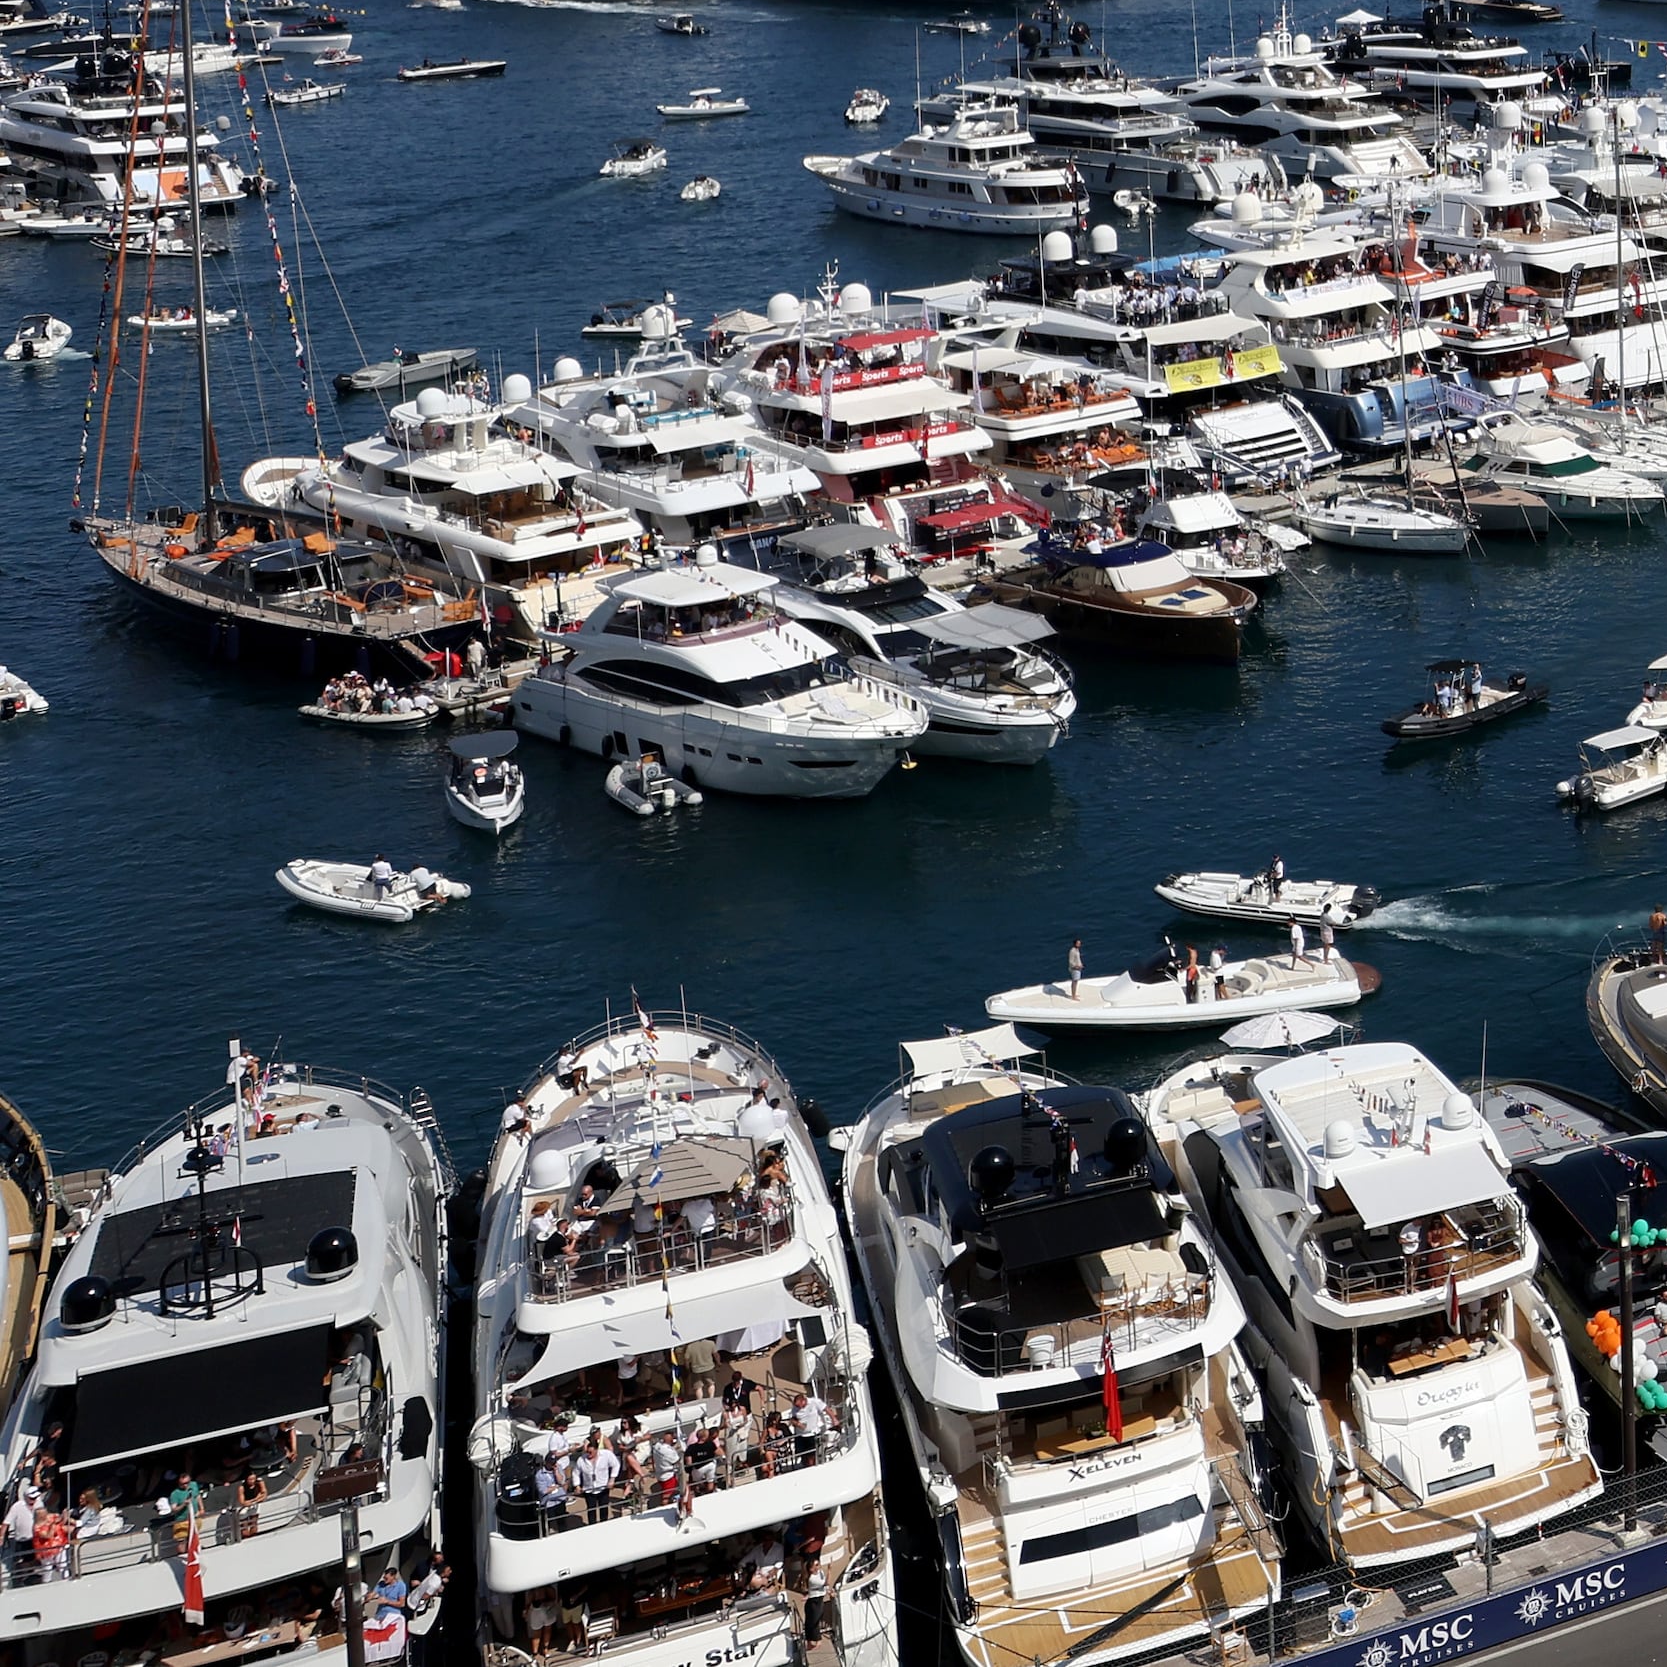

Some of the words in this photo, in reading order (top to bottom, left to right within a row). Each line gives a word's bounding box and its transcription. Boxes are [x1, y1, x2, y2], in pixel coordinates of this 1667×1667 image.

[862, 368, 888, 382] Sports
[898, 363, 924, 376] Sports
[1453, 396, 1473, 410] UBS
[874, 431, 903, 446] Sports
[1068, 1453, 1142, 1483] X-ELEVEN
[1448, 1462, 1472, 1473] MONACO
[1089, 1506, 1134, 1524] CHESTER
[1555, 1563, 1626, 1608] MSC
[1555, 1590, 1626, 1619] CRUISES
[1400, 1614, 1474, 1659] MSC
[705, 1642, 760, 1667] Star
[1400, 1640, 1474, 1667] CRUISES
